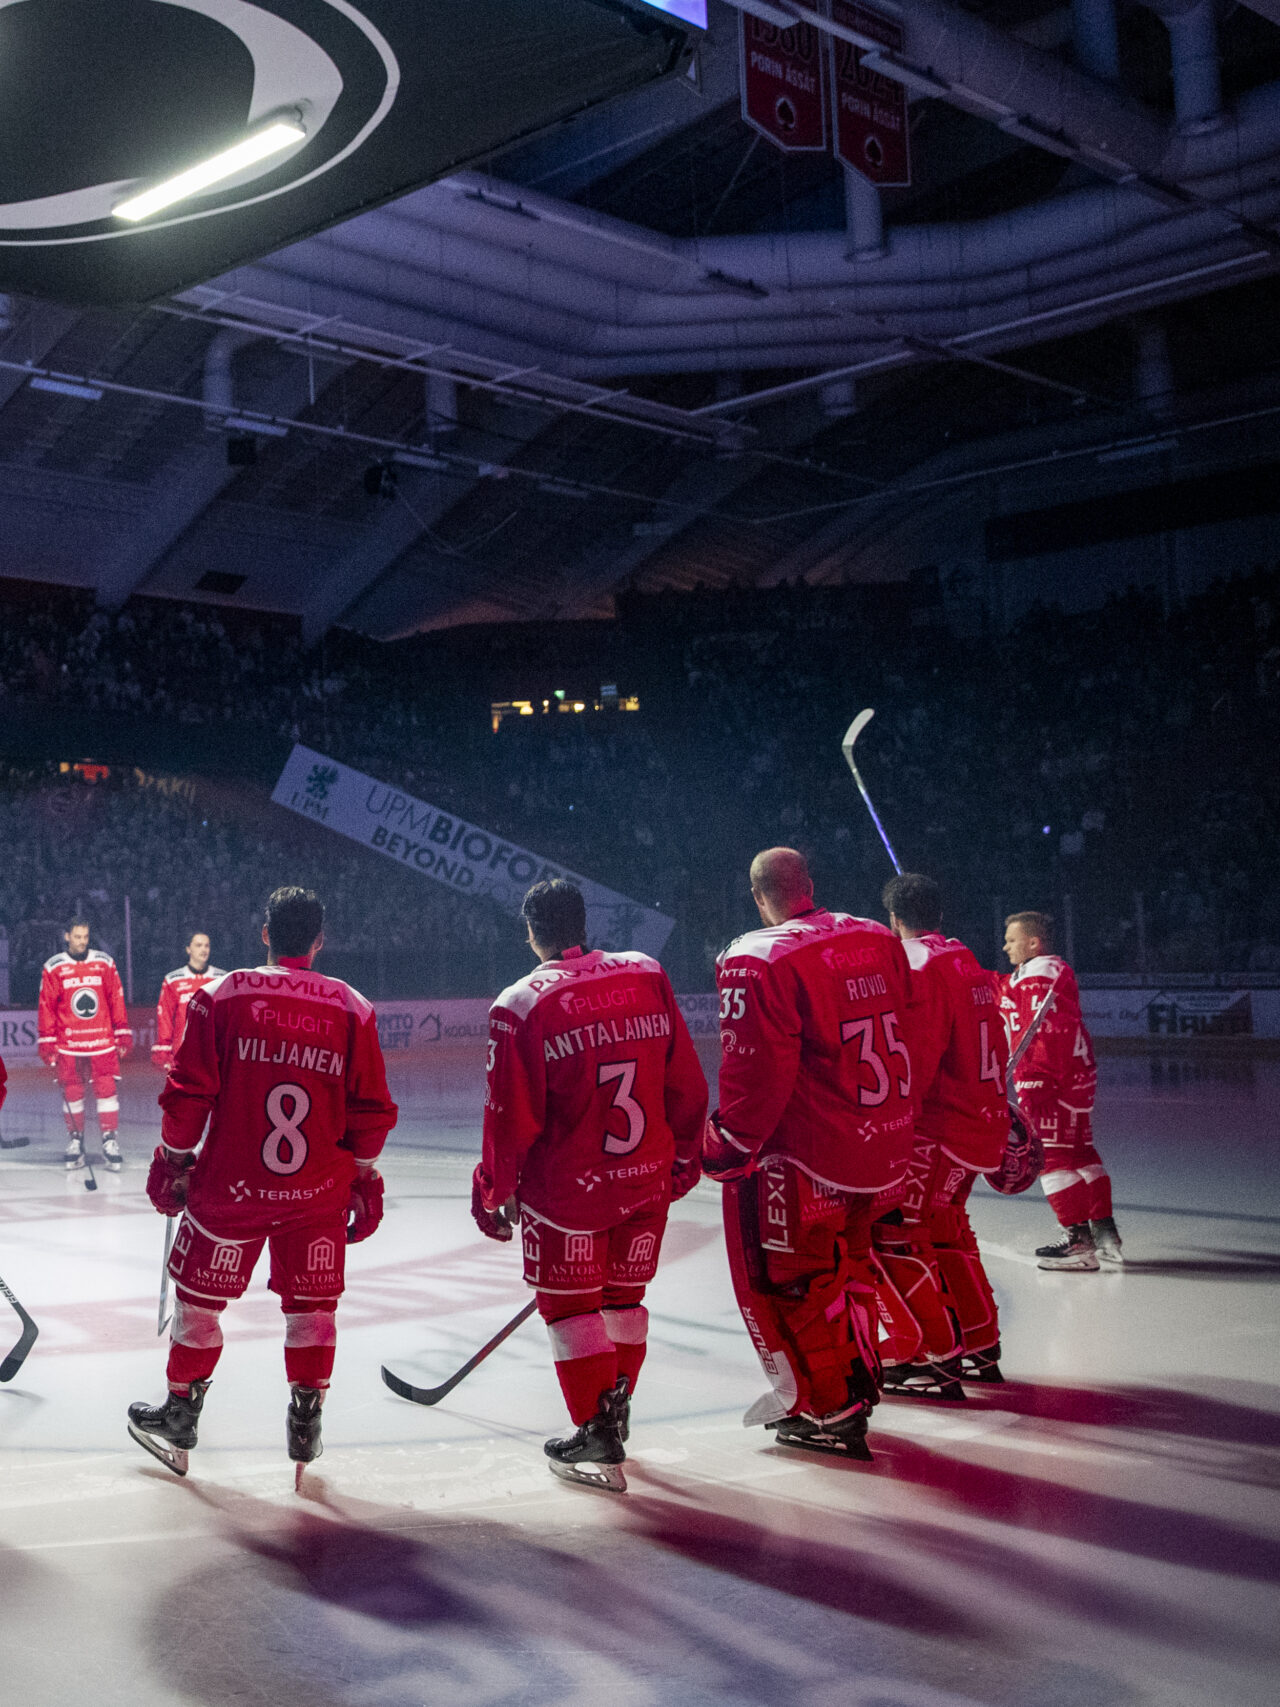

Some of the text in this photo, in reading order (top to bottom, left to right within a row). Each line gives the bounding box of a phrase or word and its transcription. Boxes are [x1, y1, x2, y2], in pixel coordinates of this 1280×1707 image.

[370, 825, 475, 888] BEYOND
[232, 971, 347, 1005] PUUVILLA
[528, 958, 641, 994] PUUVILLA
[572, 987, 638, 1015] PLUGIT
[718, 987, 747, 1020] 35
[263, 1008, 334, 1035] PLUGIT
[543, 1012, 671, 1063] ANTTALAINEN
[1009, 1011, 1021, 1032] C
[237, 1036, 344, 1077] VILJANEN
[486, 1038, 499, 1072] 3
[840, 1010, 912, 1107] 35
[597, 1060, 647, 1156] 3
[261, 1083, 312, 1176] 8
[191, 1267, 246, 1284] ASTORA
[547, 1262, 602, 1277] ASTORA
[741, 1306, 779, 1376] BAUER
